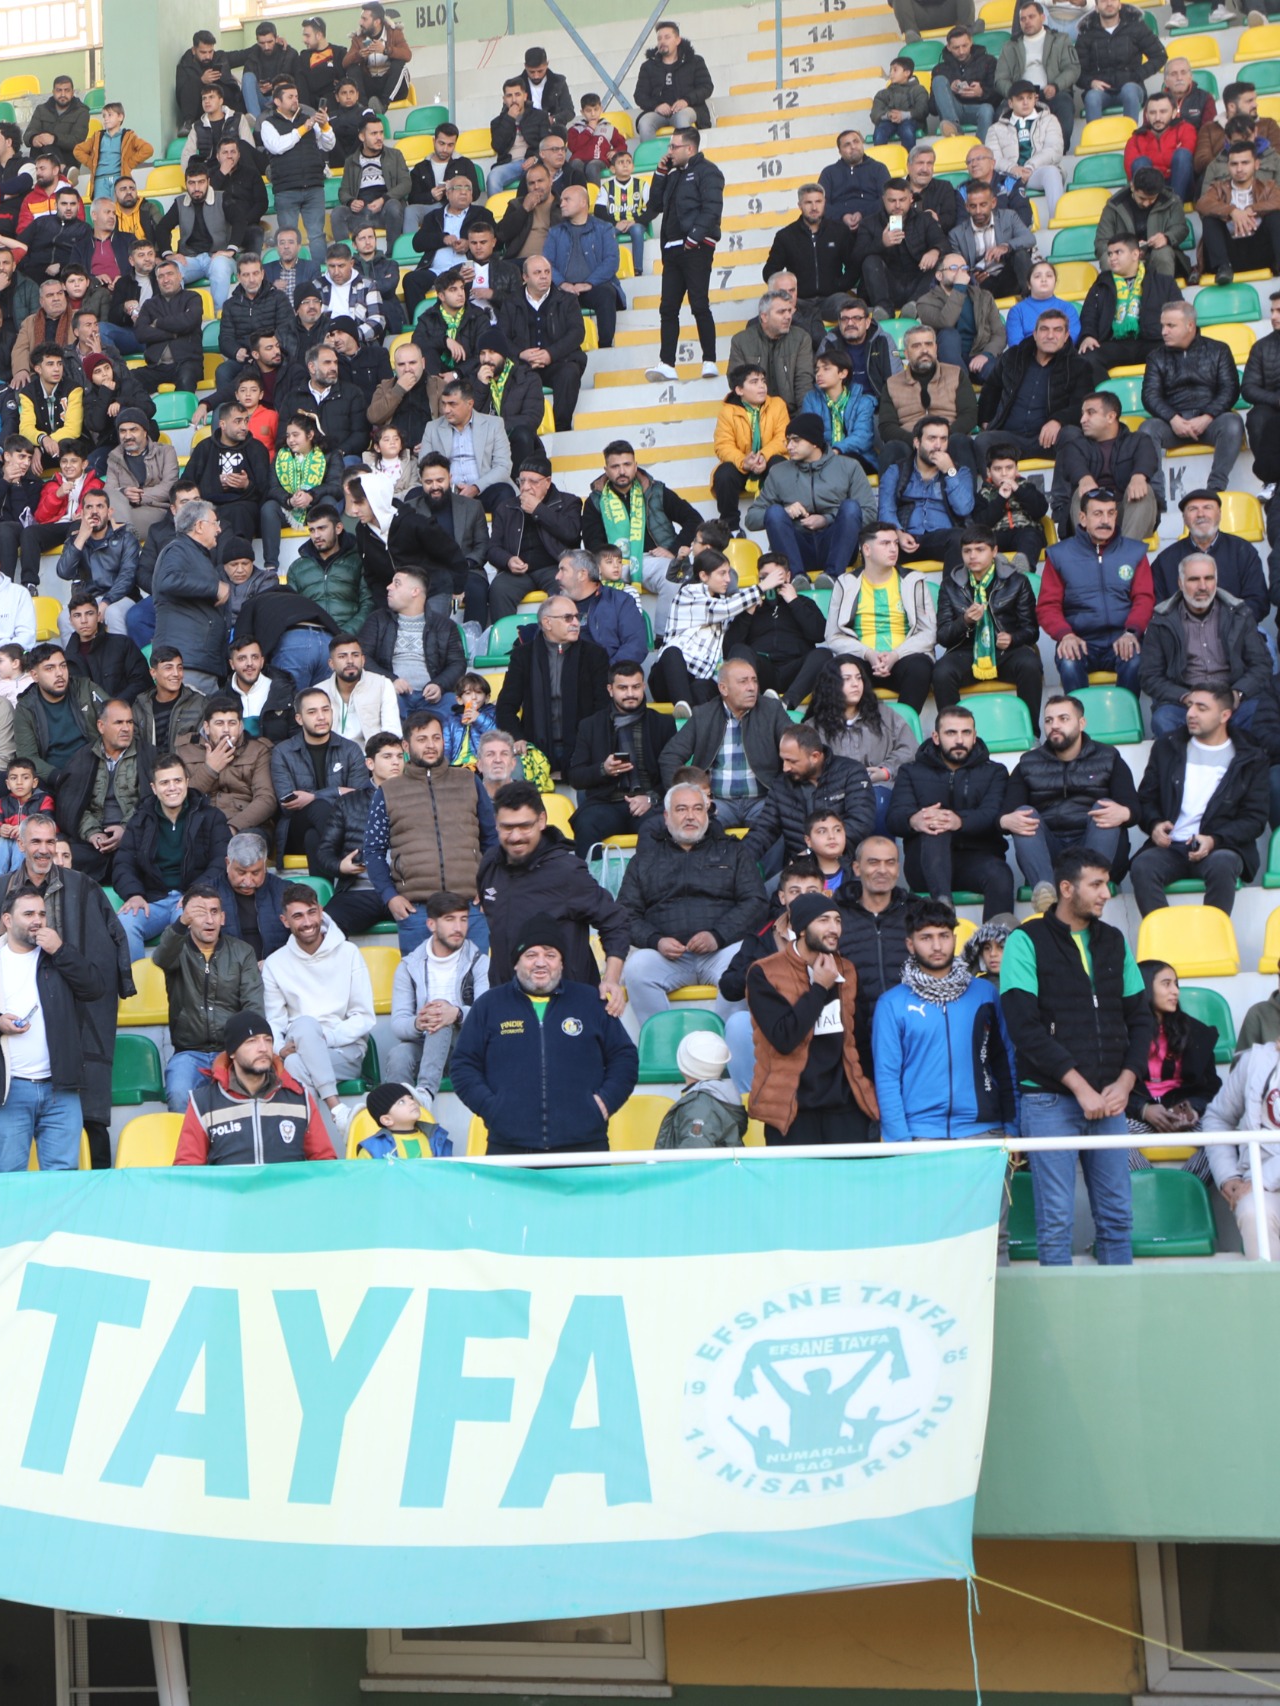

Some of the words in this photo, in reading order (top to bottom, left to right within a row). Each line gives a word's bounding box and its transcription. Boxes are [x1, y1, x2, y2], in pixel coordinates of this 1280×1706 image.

[807, 24, 834, 43] 14
[789, 56, 815, 74] 13
[773, 91, 799, 111] 12
[767, 121, 790, 140] 11
[757, 159, 782, 178] 10
[748, 198, 762, 214] 9
[717, 269, 732, 289] 7
[678, 342, 694, 362] 5
[659, 385, 677, 404] 4
[640, 426, 656, 448] 3
[695, 1286, 841, 1362] EFSANE
[861, 1286, 956, 1338] TAYFA
[769, 1338, 834, 1357] EFSANE
[839, 1333, 890, 1351] TAYFA
[18, 1262, 651, 1507] TAYFA
[861, 1395, 954, 1477] RUHU
[766, 1443, 864, 1464] NUMARALI
